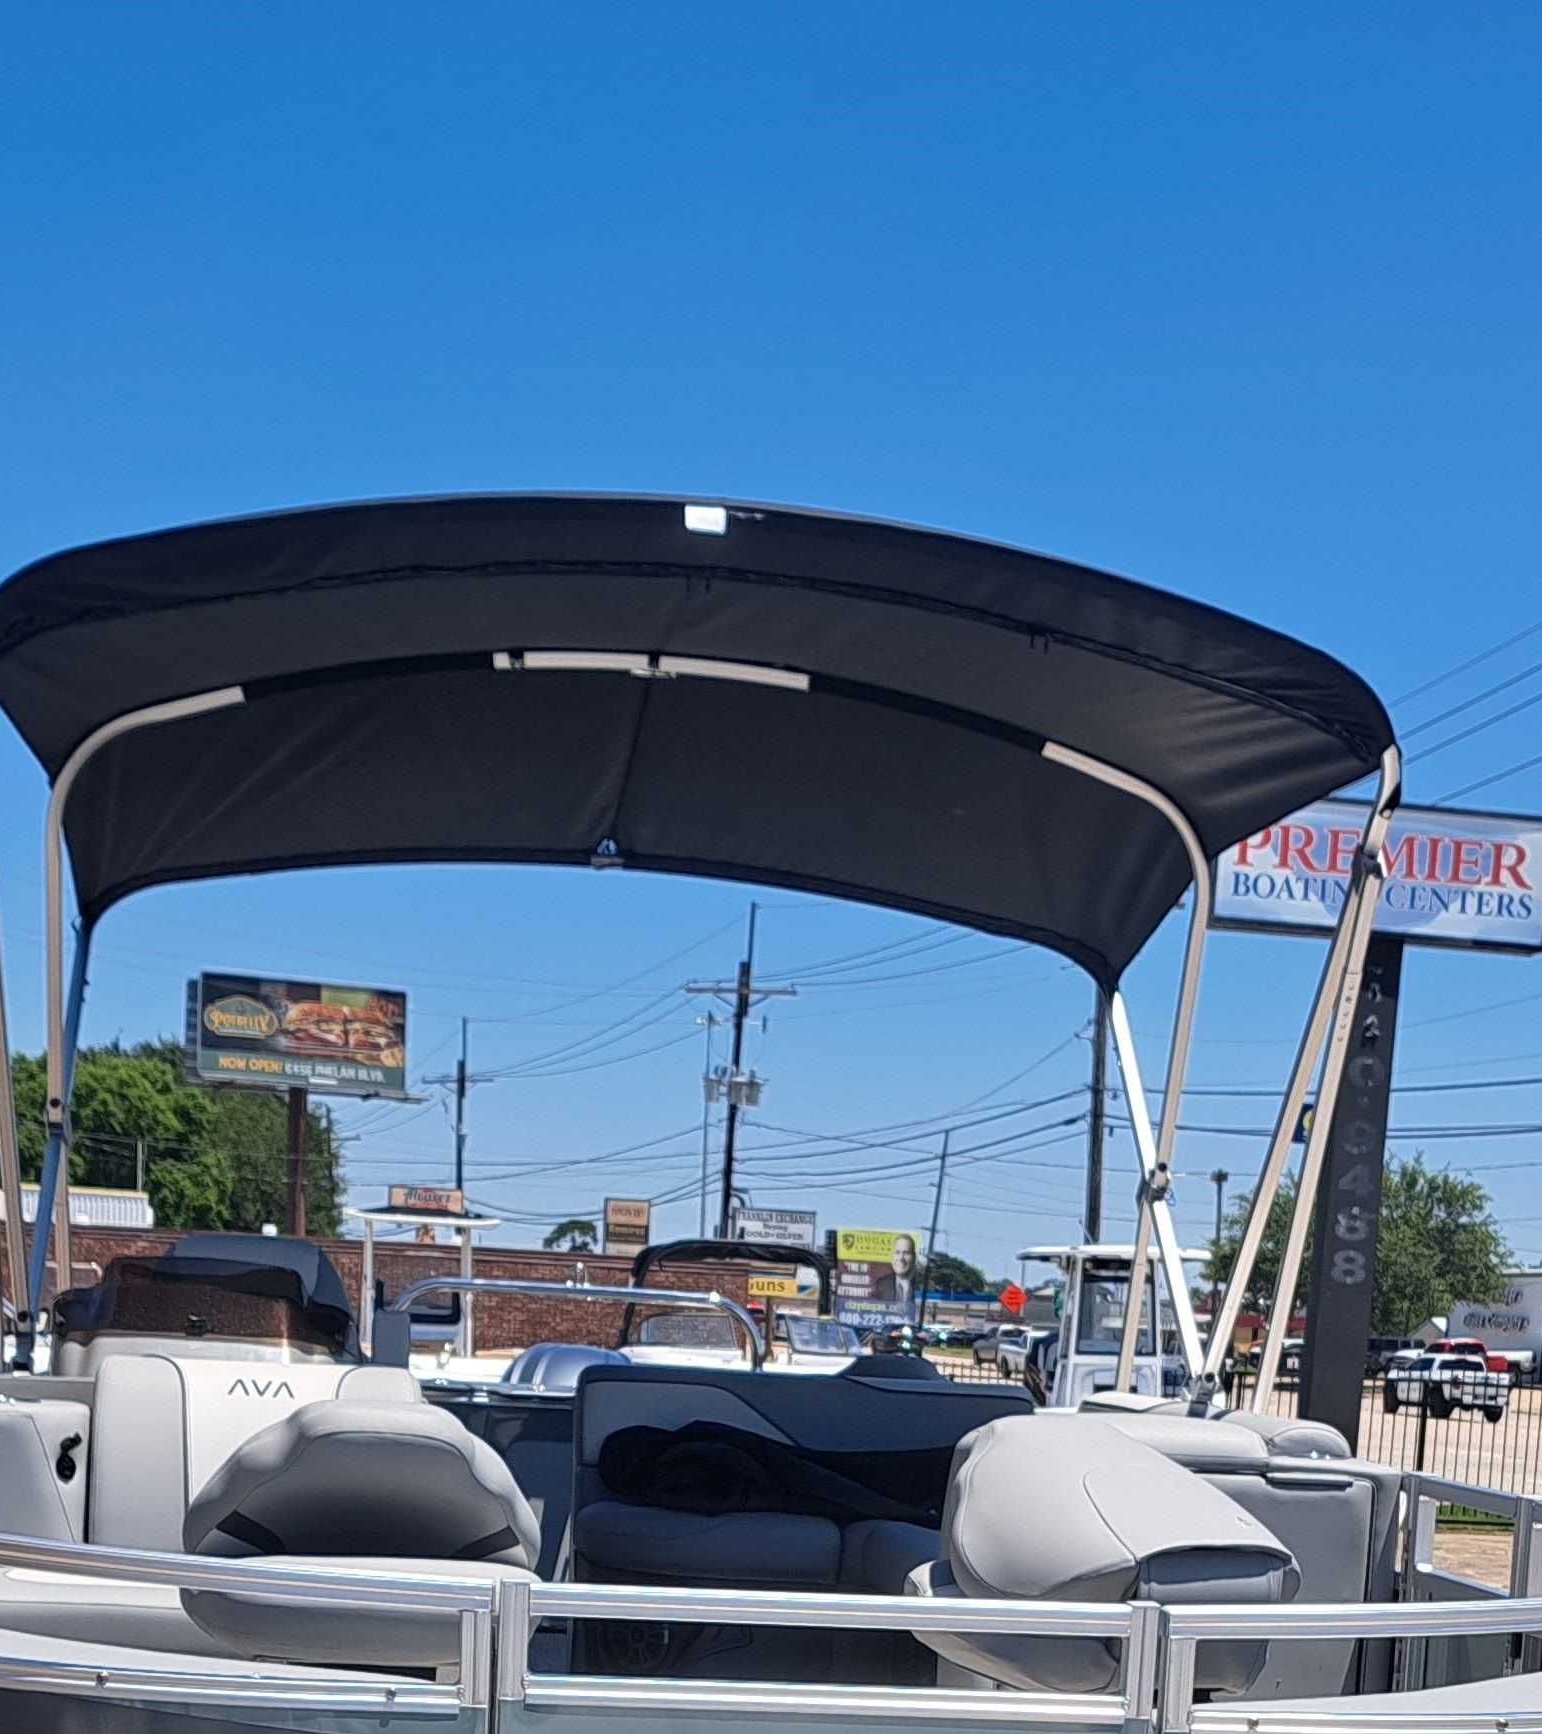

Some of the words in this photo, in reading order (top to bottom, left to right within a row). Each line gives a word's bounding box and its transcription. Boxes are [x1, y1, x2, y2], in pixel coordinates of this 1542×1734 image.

[1233, 822, 1533, 890] PREMIER
[1231, 872, 1348, 905] BOATIN
[1385, 883, 1533, 920] CENTERS
